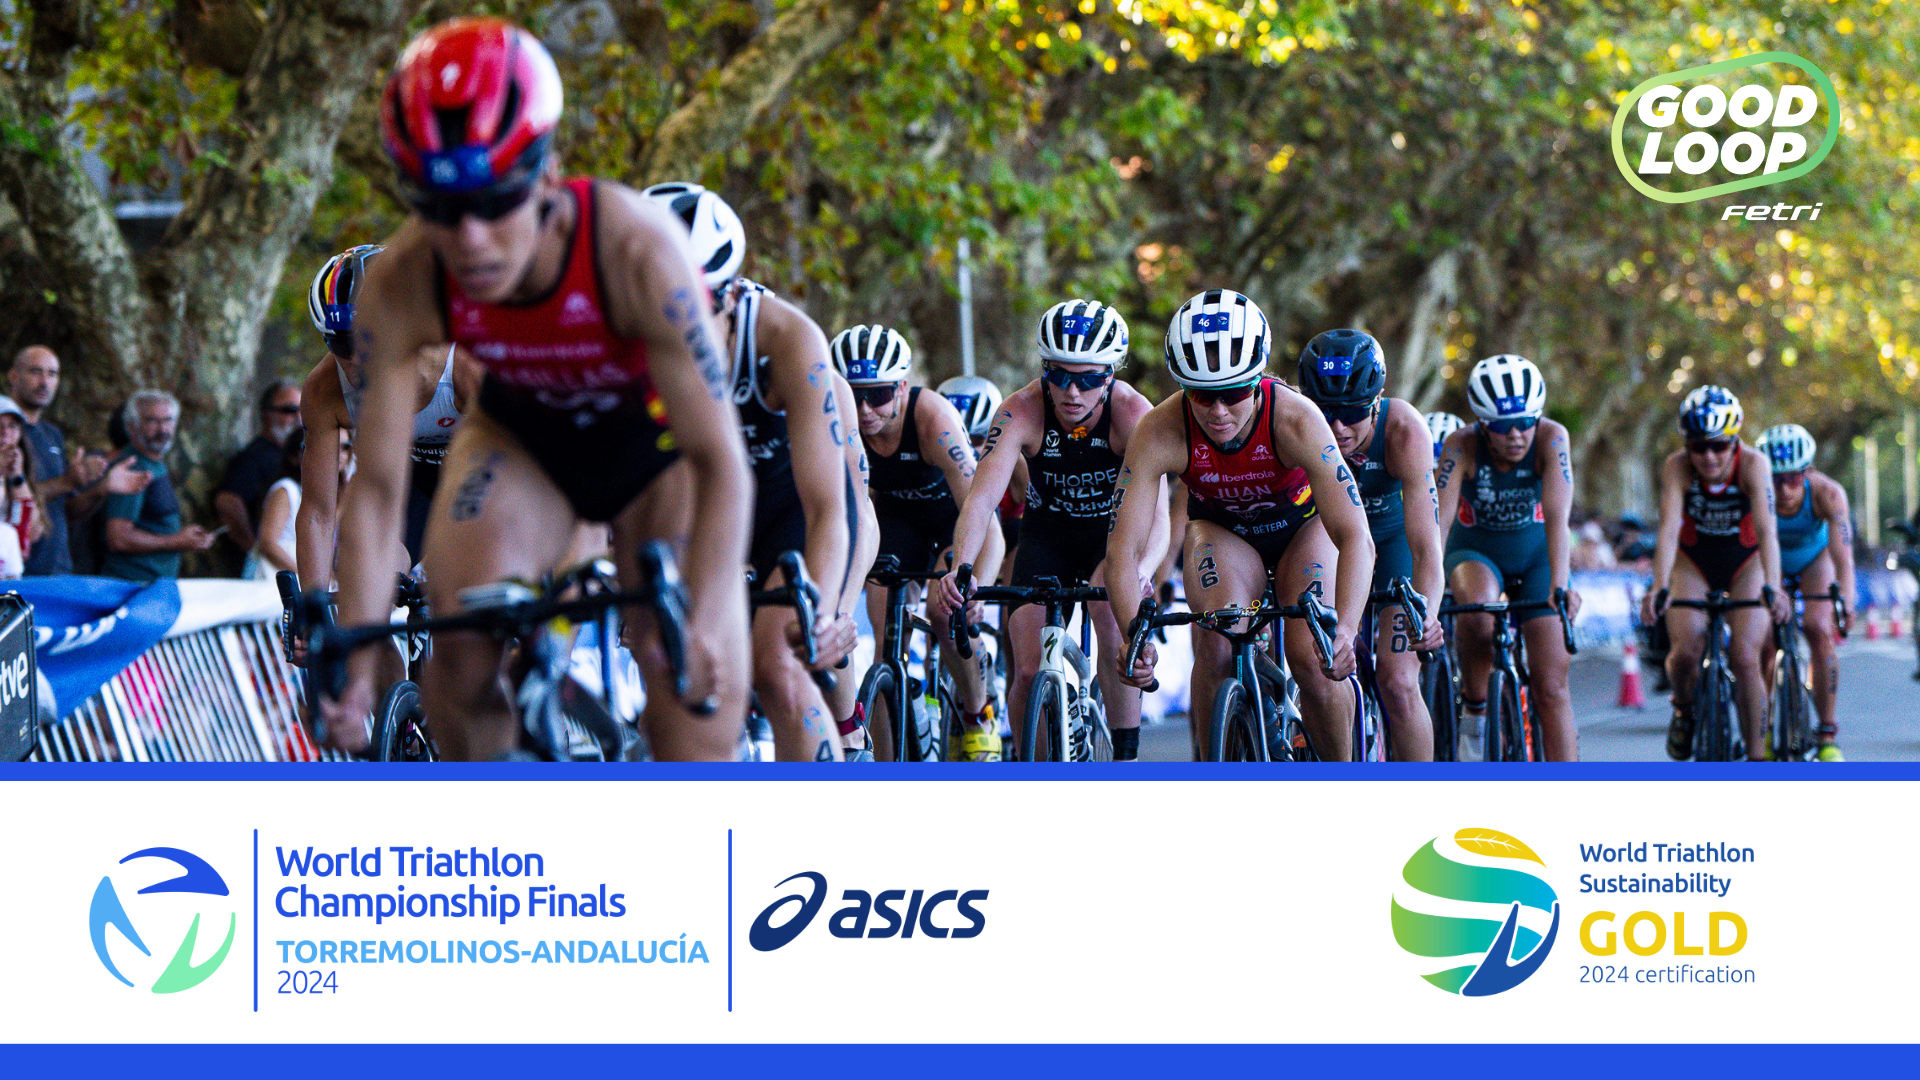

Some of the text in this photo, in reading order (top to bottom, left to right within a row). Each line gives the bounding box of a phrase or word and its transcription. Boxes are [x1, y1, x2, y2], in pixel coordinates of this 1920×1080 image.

[329, 311, 340, 322] 11
[1064, 319, 1076, 329] 27
[1198, 317, 1210, 328] 46
[851, 364, 861, 374] 63
[1323, 361, 1335, 370] 30
[978, 426, 1002, 463] 27
[1043, 468, 1117, 487] THORPE
[1222, 471, 1275, 482] Iberdrola
[1214, 484, 1272, 500] JUAN
[1197, 556, 1219, 590] 46
[1391, 613, 1409, 653] 30
